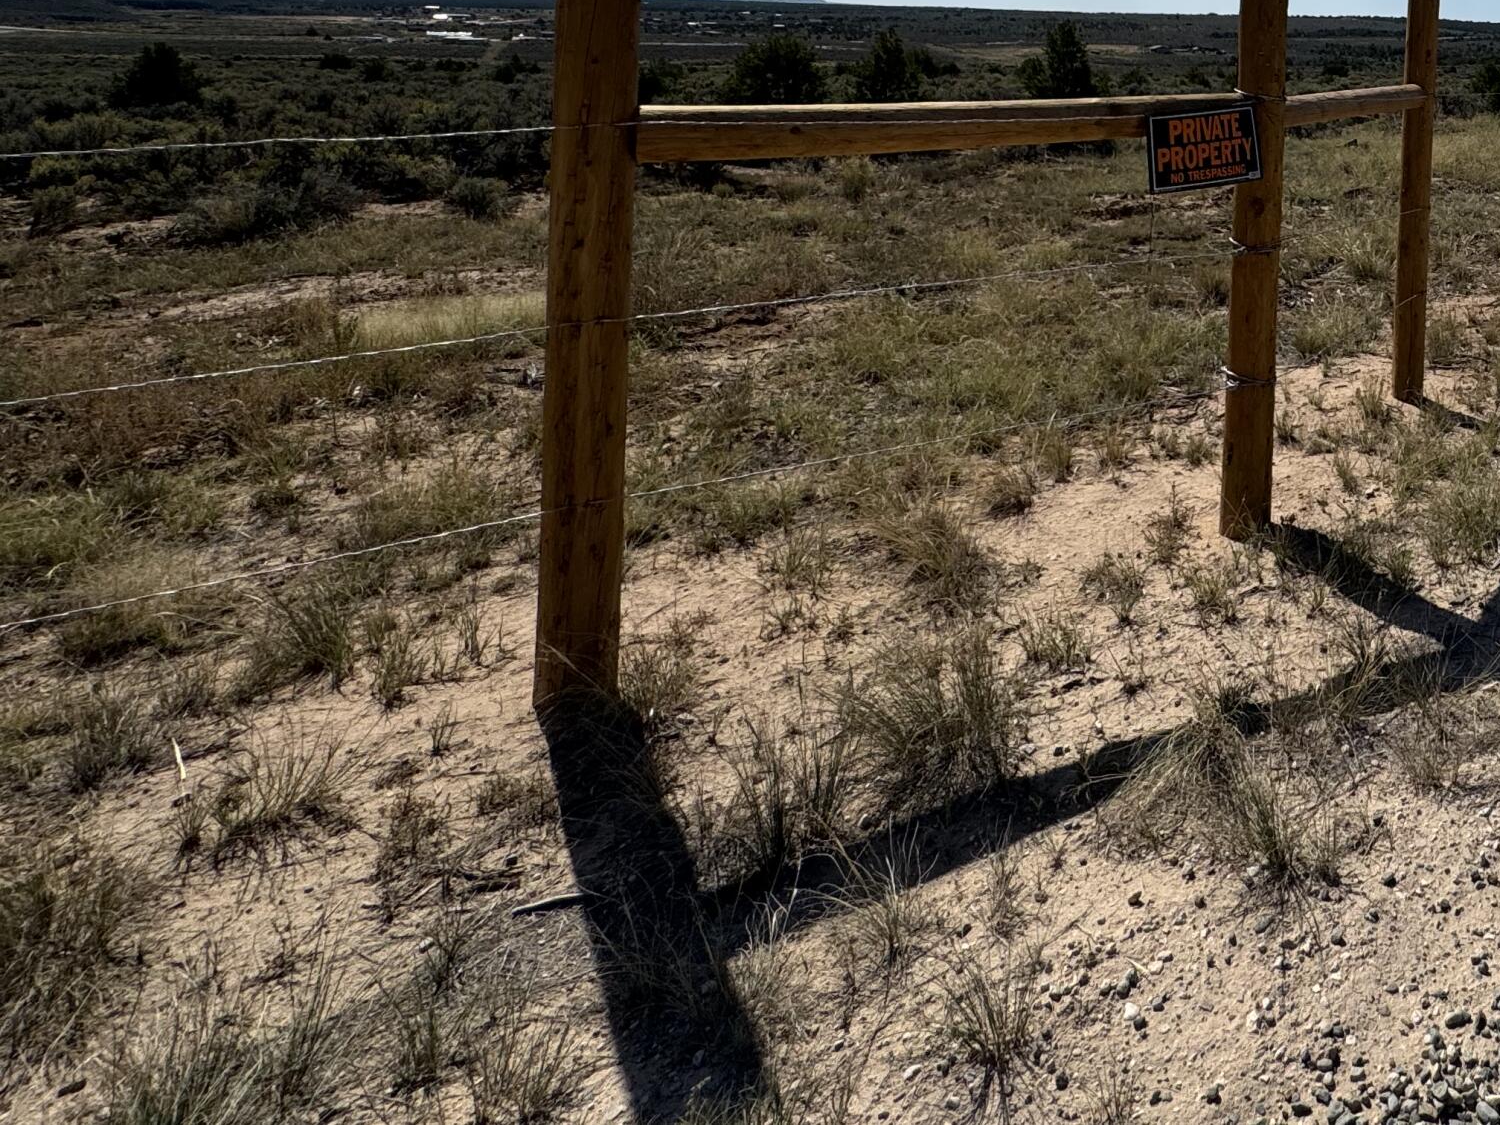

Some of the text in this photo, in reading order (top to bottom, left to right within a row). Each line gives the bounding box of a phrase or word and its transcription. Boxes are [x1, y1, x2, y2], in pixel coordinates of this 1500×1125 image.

[1168, 113, 1242, 144] PRIVATE
[1157, 137, 1252, 172] PROPERTY
[1170, 172, 1184, 183] NO
[1187, 164, 1246, 181] TRESPASSING
